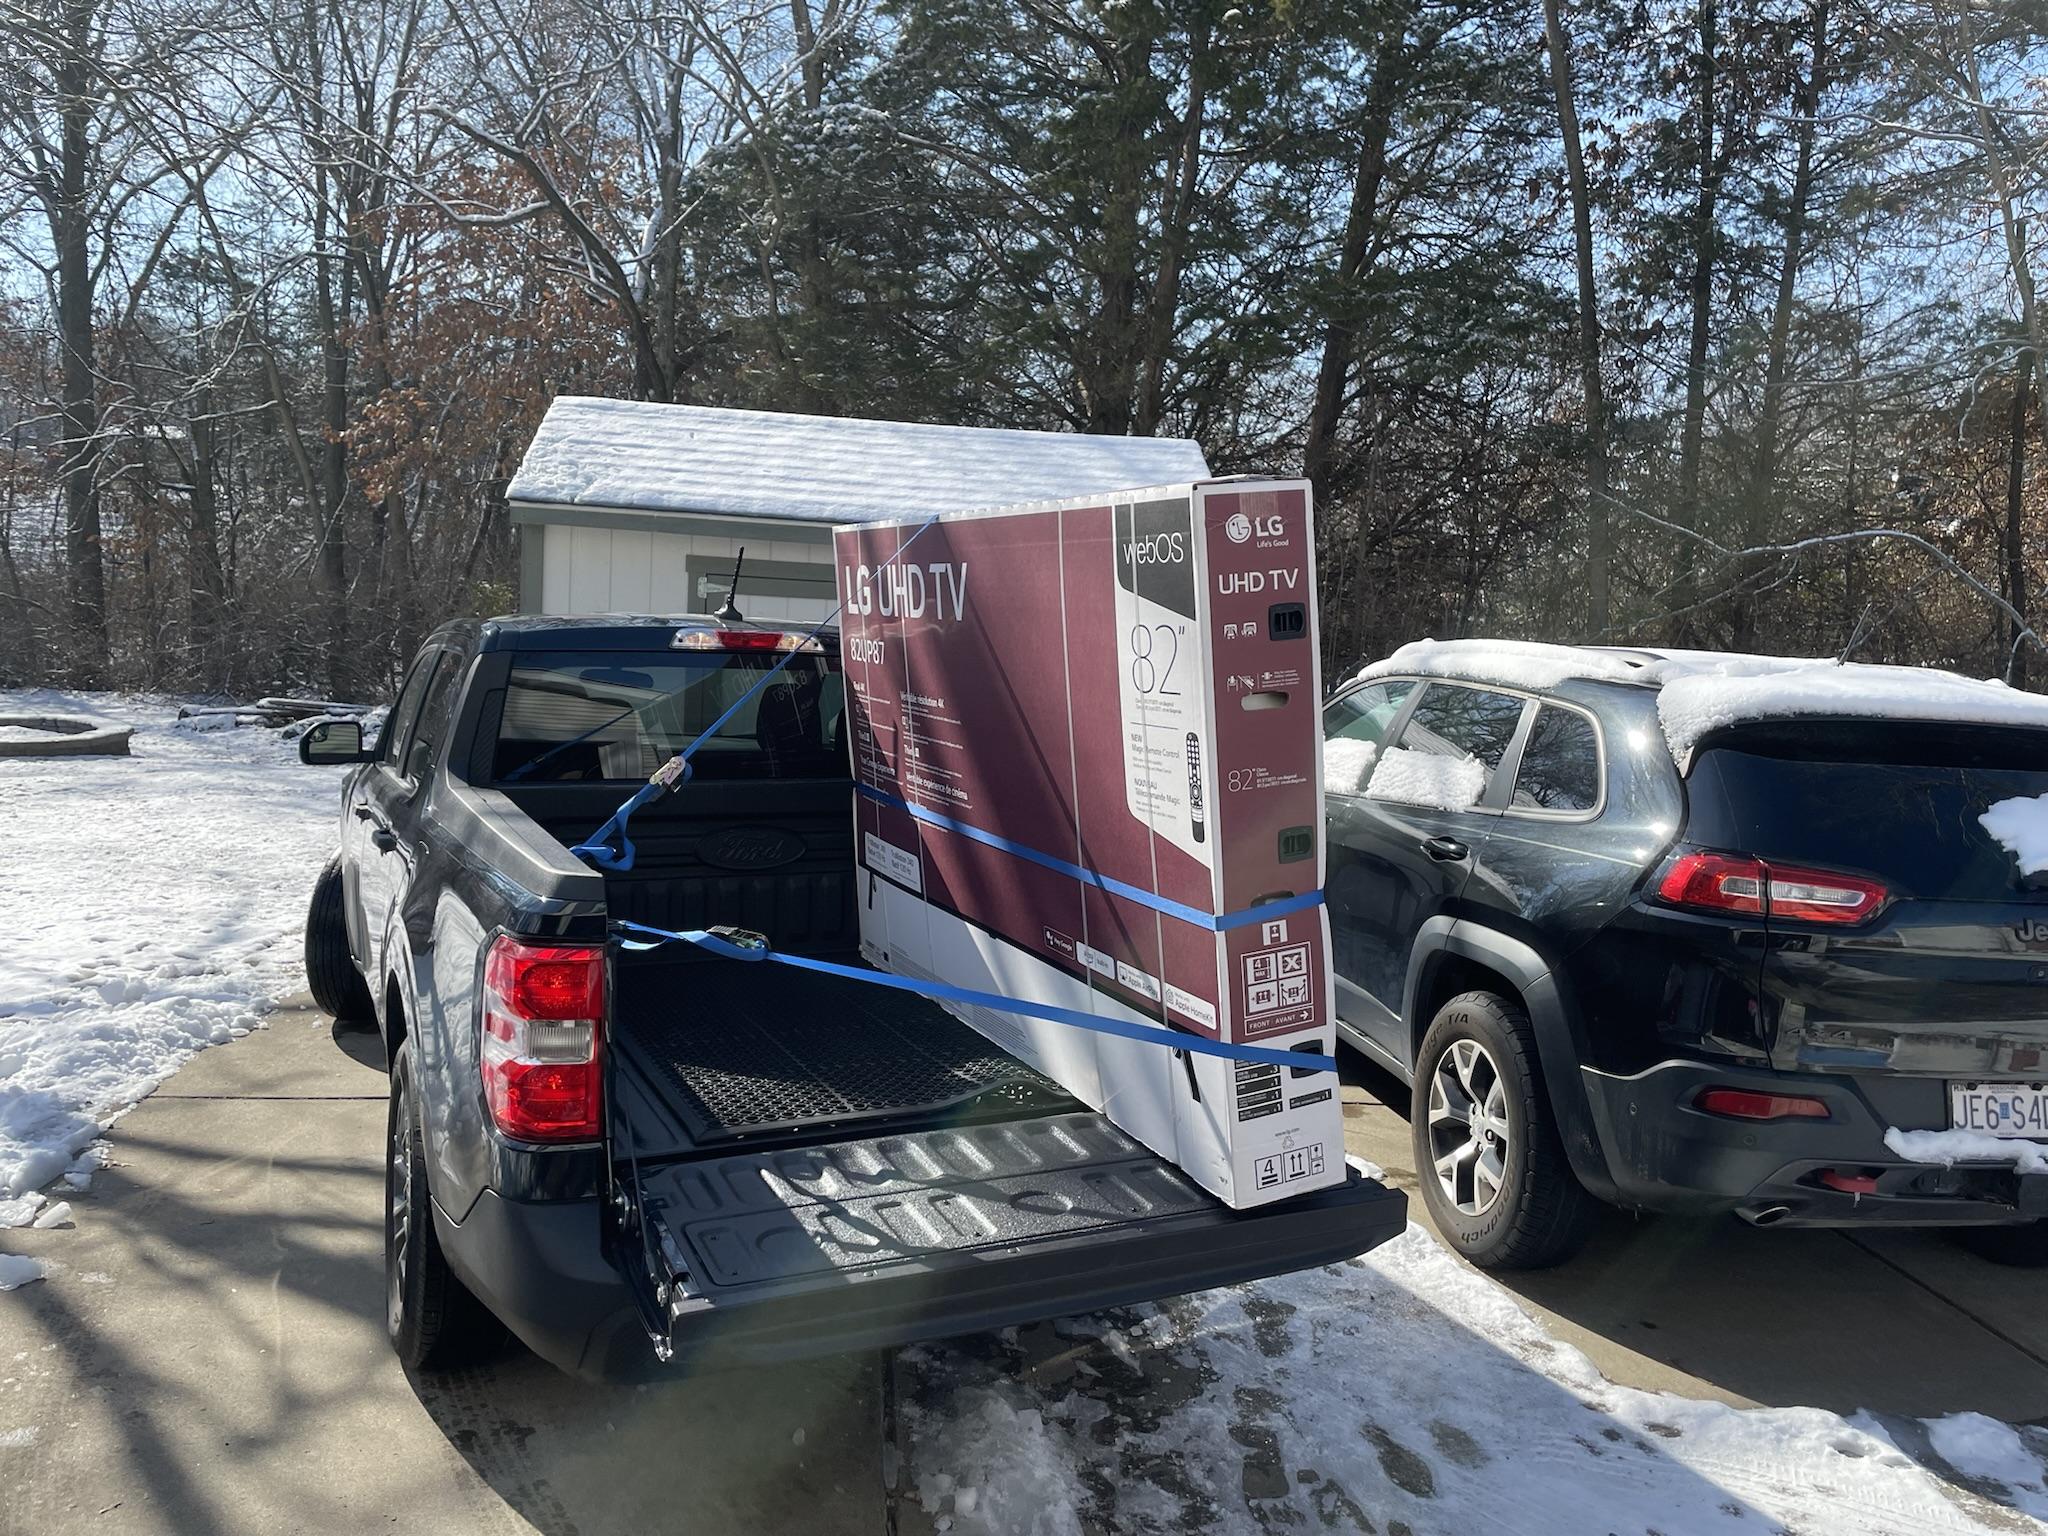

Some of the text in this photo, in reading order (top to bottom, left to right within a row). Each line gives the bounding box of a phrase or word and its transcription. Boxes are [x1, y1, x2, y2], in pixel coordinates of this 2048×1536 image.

[1255, 515, 1284, 537] LG
[1123, 532, 1184, 564] webOS
[845, 562, 968, 621] LG UHD TV
[1218, 568, 1298, 594] UHD TV
[850, 638, 884, 665] 82UP87
[1163, 748, 1180, 758] Control
[1254, 959, 1261, 969] 4
[1127, 976, 1142, 988] Apple
[1174, 999, 1214, 1021] Apple HomeKit
[1448, 1012, 1468, 1024] T/A
[1249, 1014, 1296, 1030] FRONT AVANT
[1955, 1095, 1999, 1130] JE6
[1264, 1159, 1275, 1174] 4
